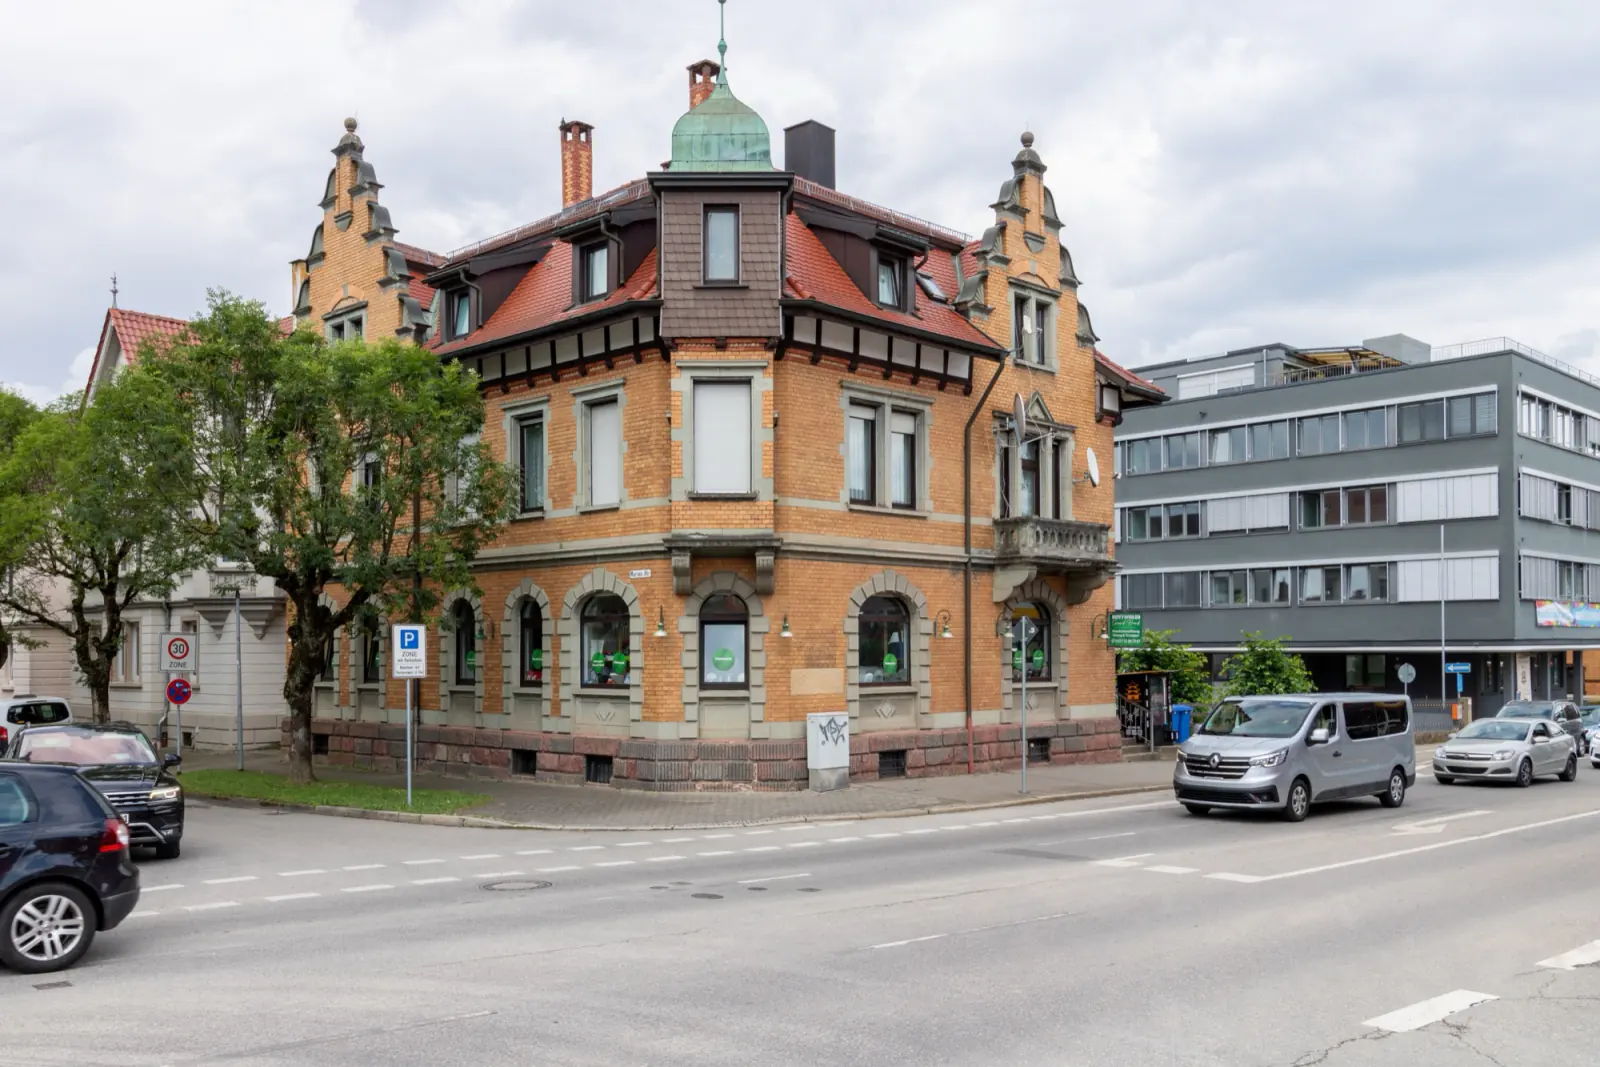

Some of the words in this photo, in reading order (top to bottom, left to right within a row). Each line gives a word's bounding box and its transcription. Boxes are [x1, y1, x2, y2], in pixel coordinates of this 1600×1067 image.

[404, 632, 415, 647] P
[172, 643, 185, 654] 30
[169, 661, 188, 669] ZONE
